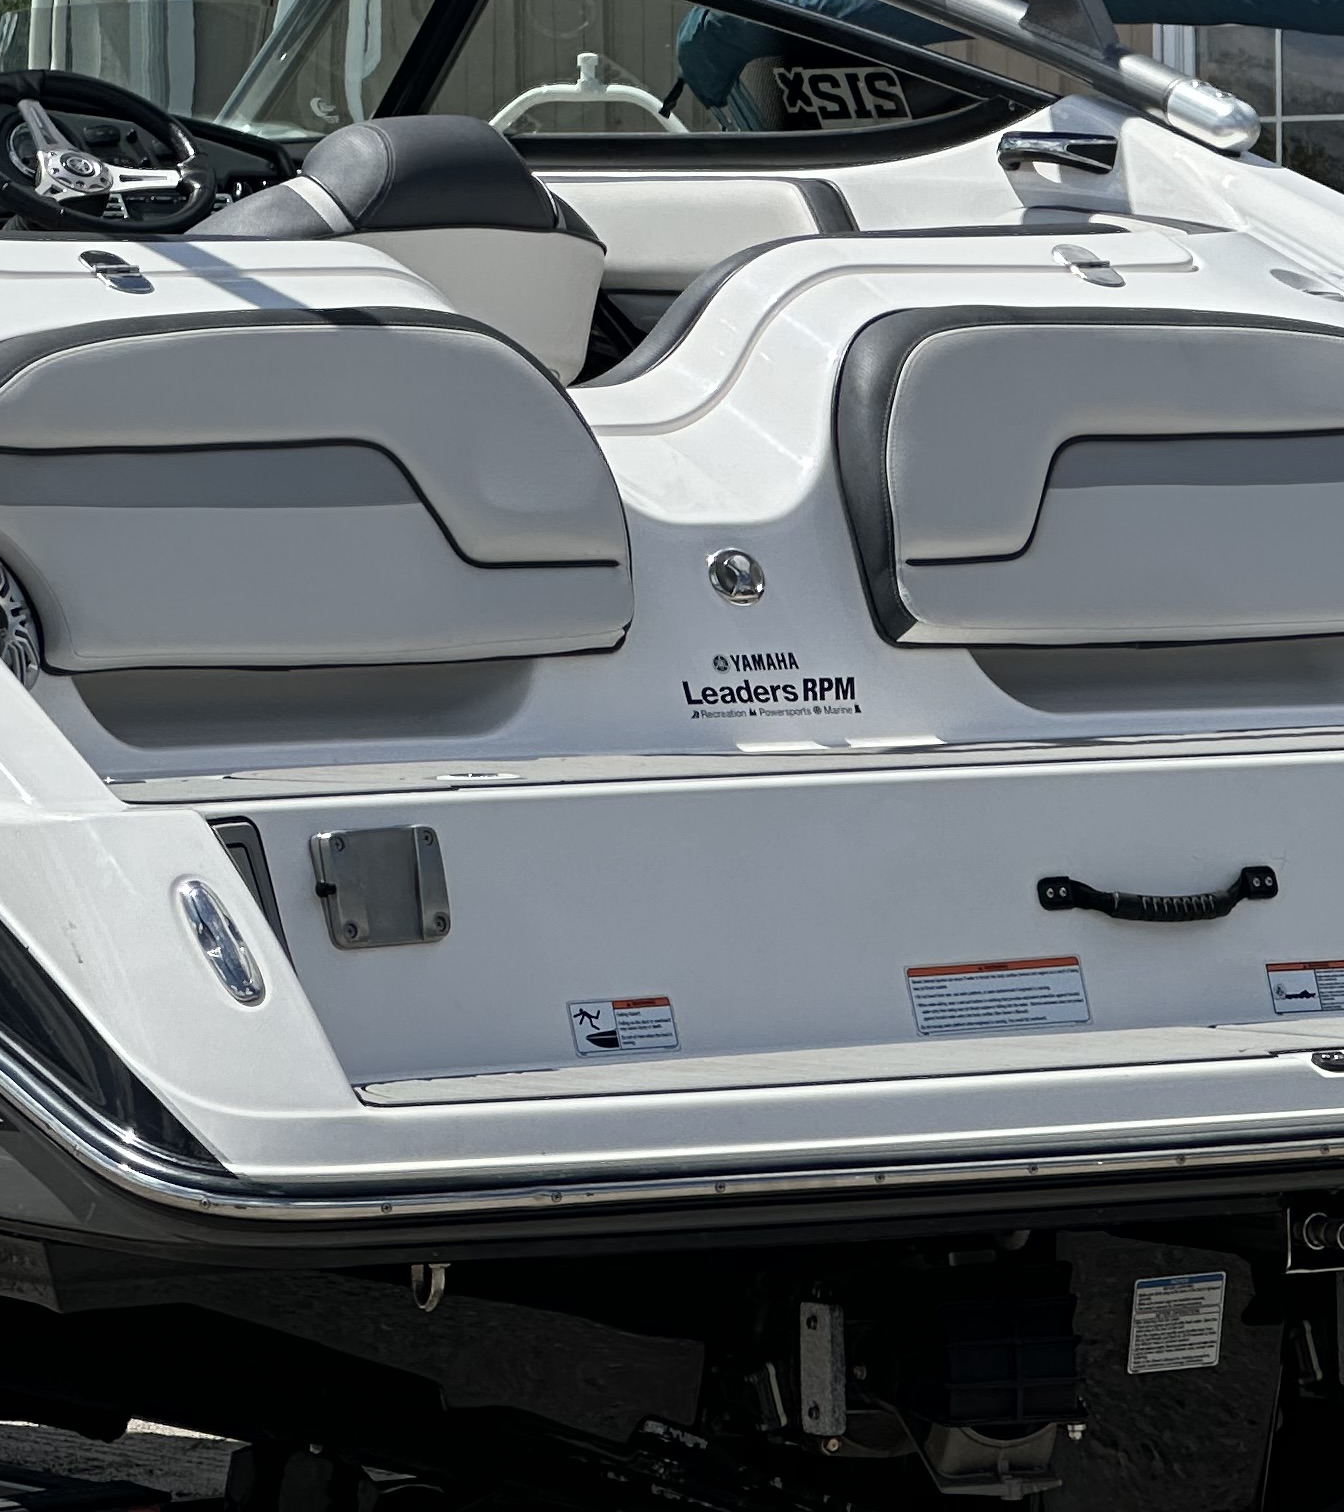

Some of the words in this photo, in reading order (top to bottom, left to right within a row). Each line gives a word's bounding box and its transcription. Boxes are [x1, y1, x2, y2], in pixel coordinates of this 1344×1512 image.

[729, 652, 800, 672] YAMAHA
[682, 679, 799, 705] Leaders
[802, 676, 856, 702] RPM
[700, 709, 747, 719] Recreation
[759, 706, 812, 717] Powersports
[823, 705, 854, 715] Marine
